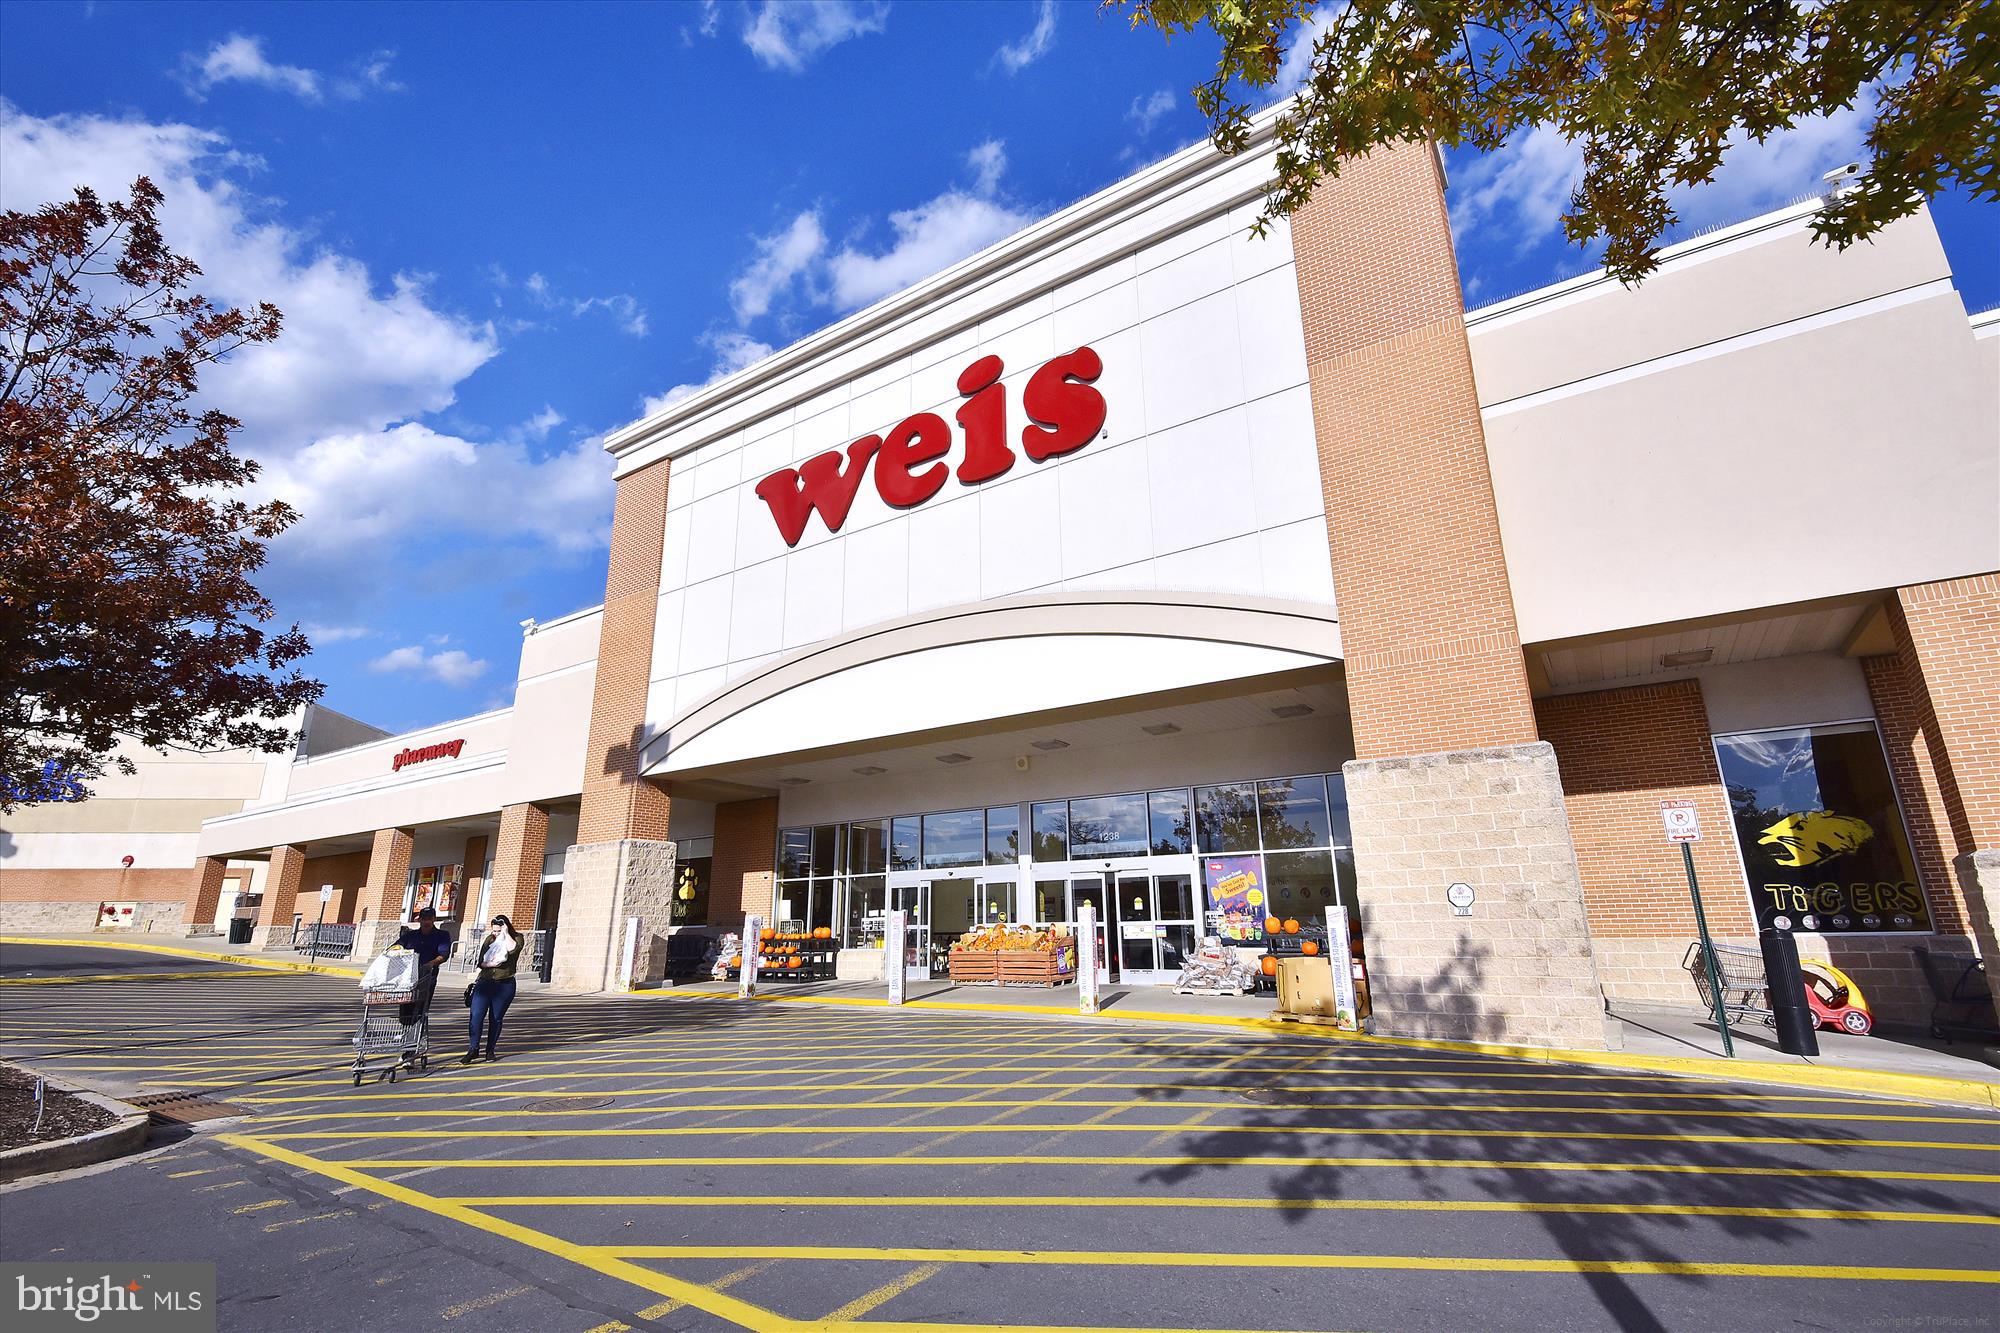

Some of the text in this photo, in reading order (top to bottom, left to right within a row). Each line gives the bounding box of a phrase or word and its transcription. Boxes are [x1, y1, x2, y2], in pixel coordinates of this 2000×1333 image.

[755, 346, 1108, 549] weis
[392, 739, 465, 772] pharmacy
[1099, 831, 1120, 841] 1238
[1330, 927, 1340, 955] HUNDREDS
[1336, 989, 1345, 1007] ITEMS
